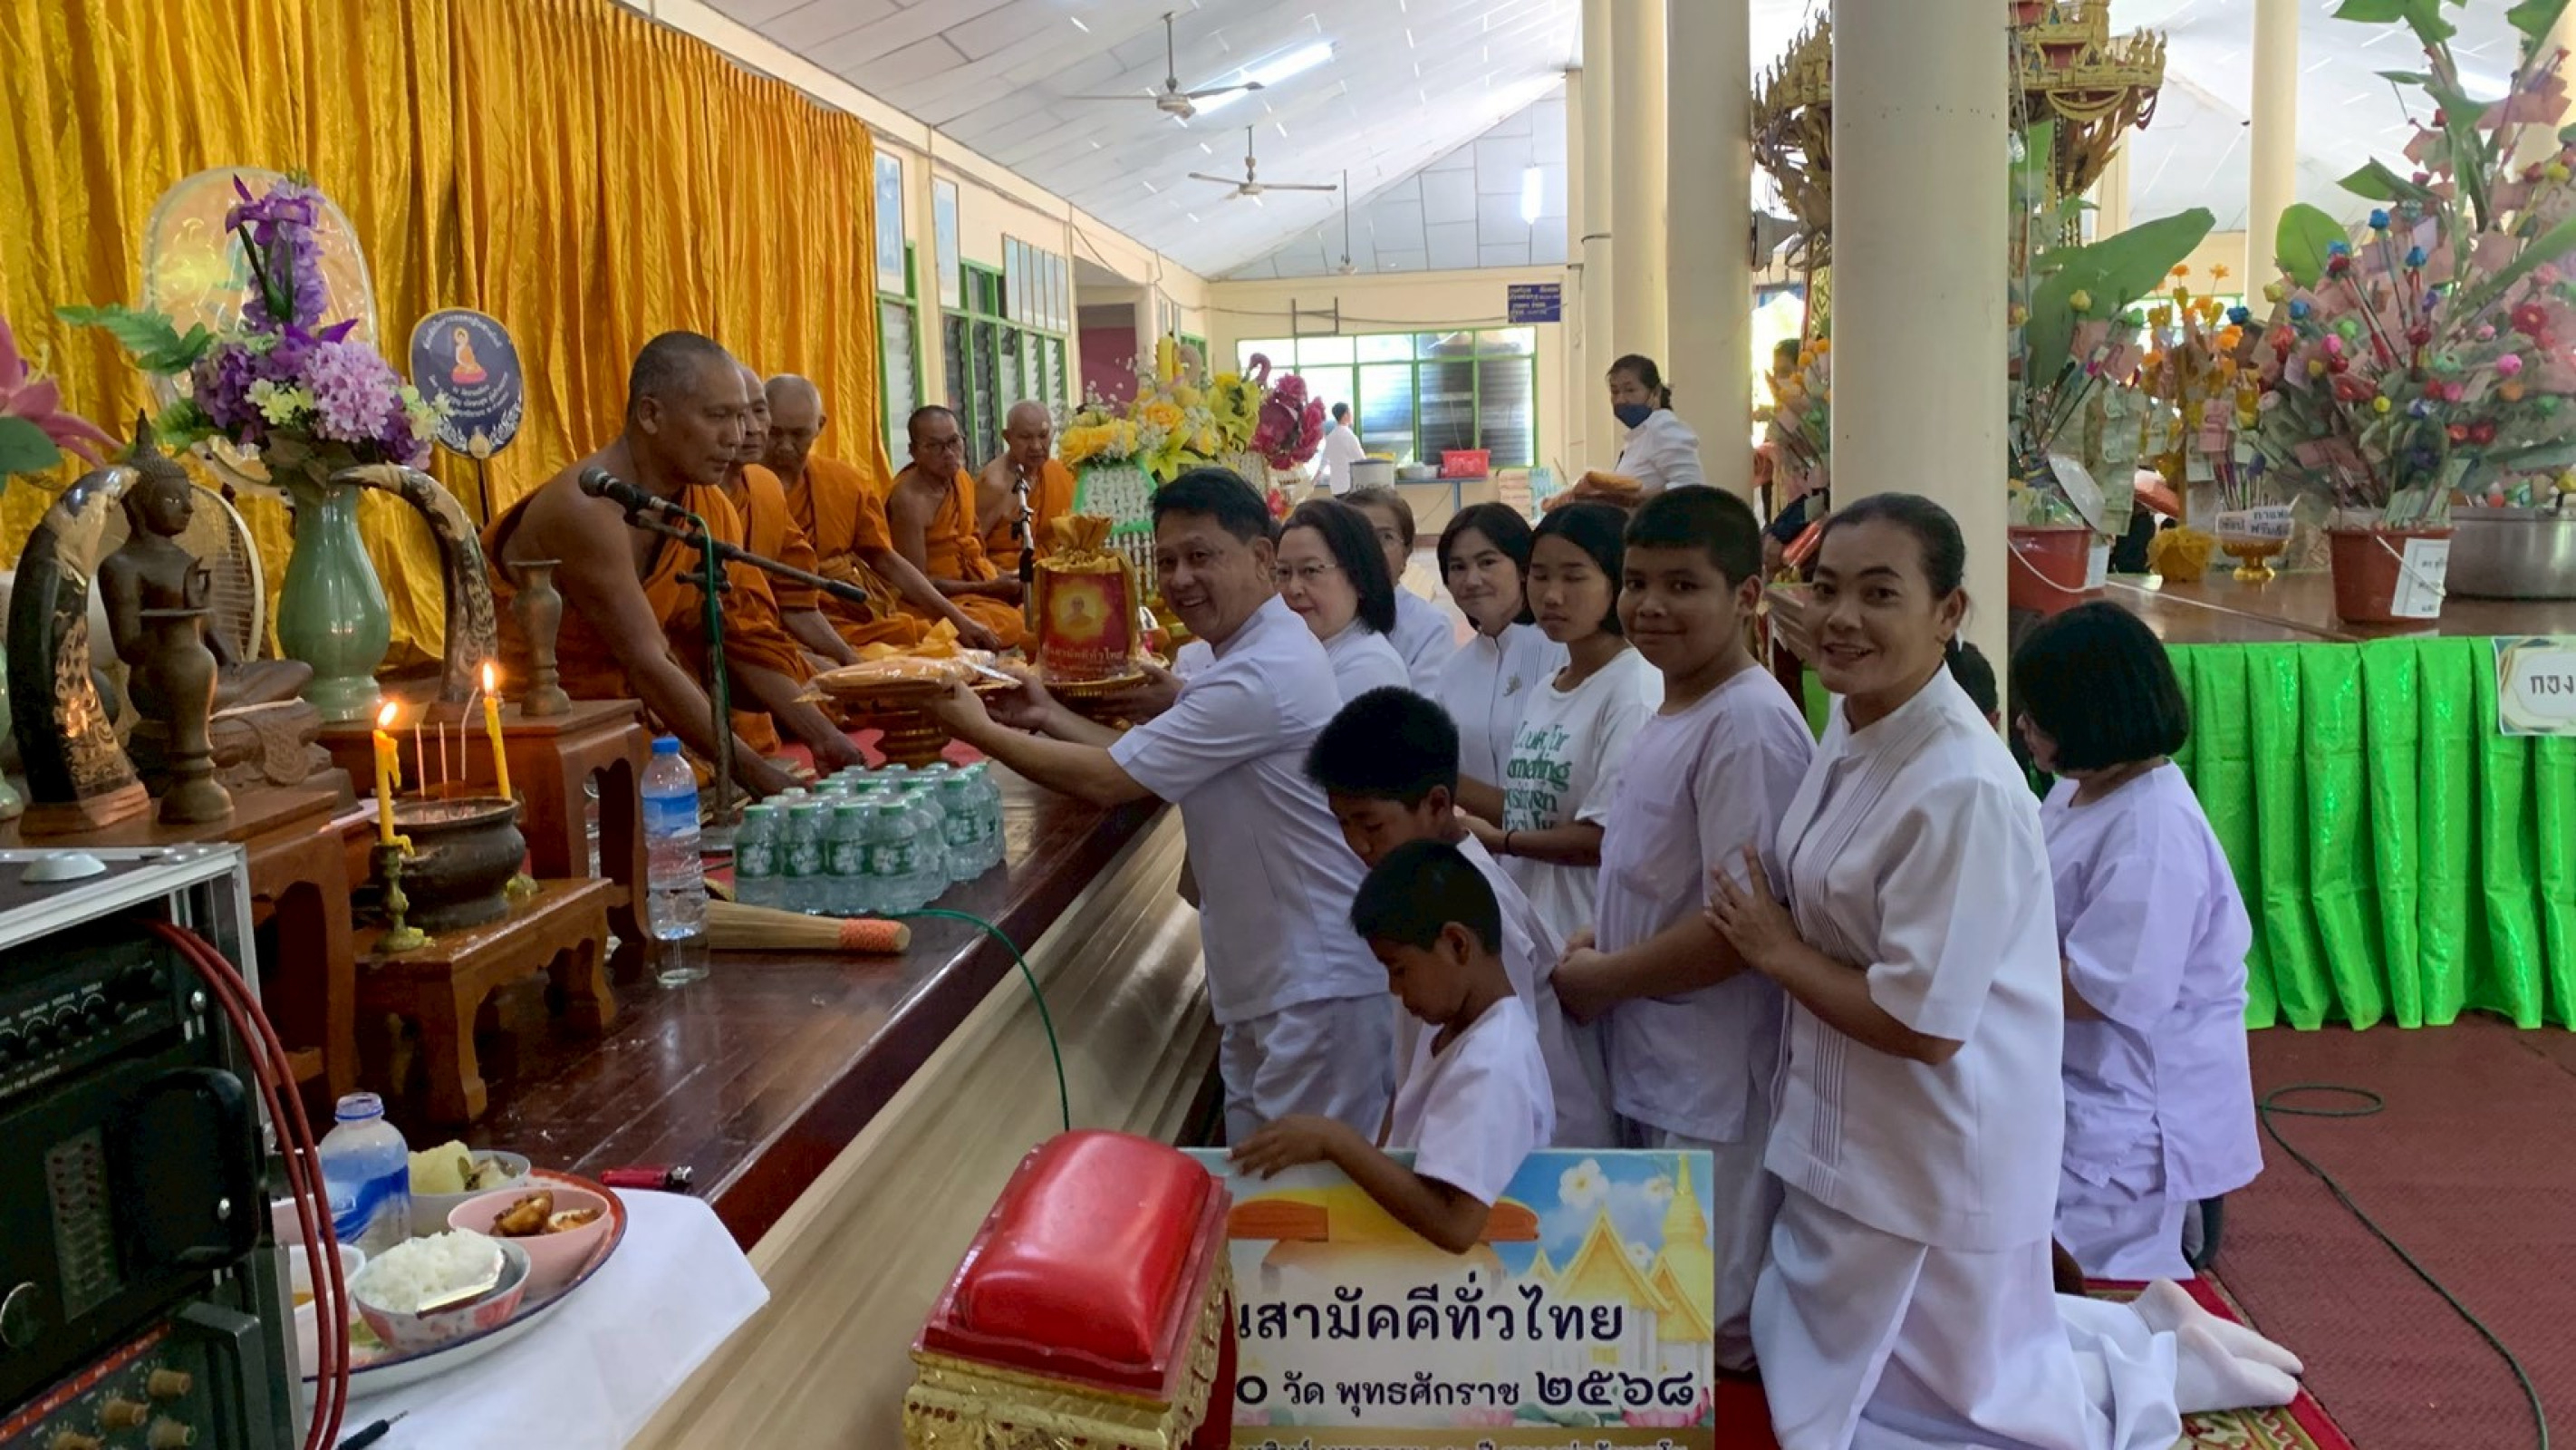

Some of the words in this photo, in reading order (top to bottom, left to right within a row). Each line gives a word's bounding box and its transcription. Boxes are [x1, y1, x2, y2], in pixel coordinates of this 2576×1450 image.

[1283, 1370, 1325, 1405] วัด
[1336, 1370, 1520, 1417] พุทธศักราช
[1535, 1369, 1694, 1406] ๒๕๖๘
